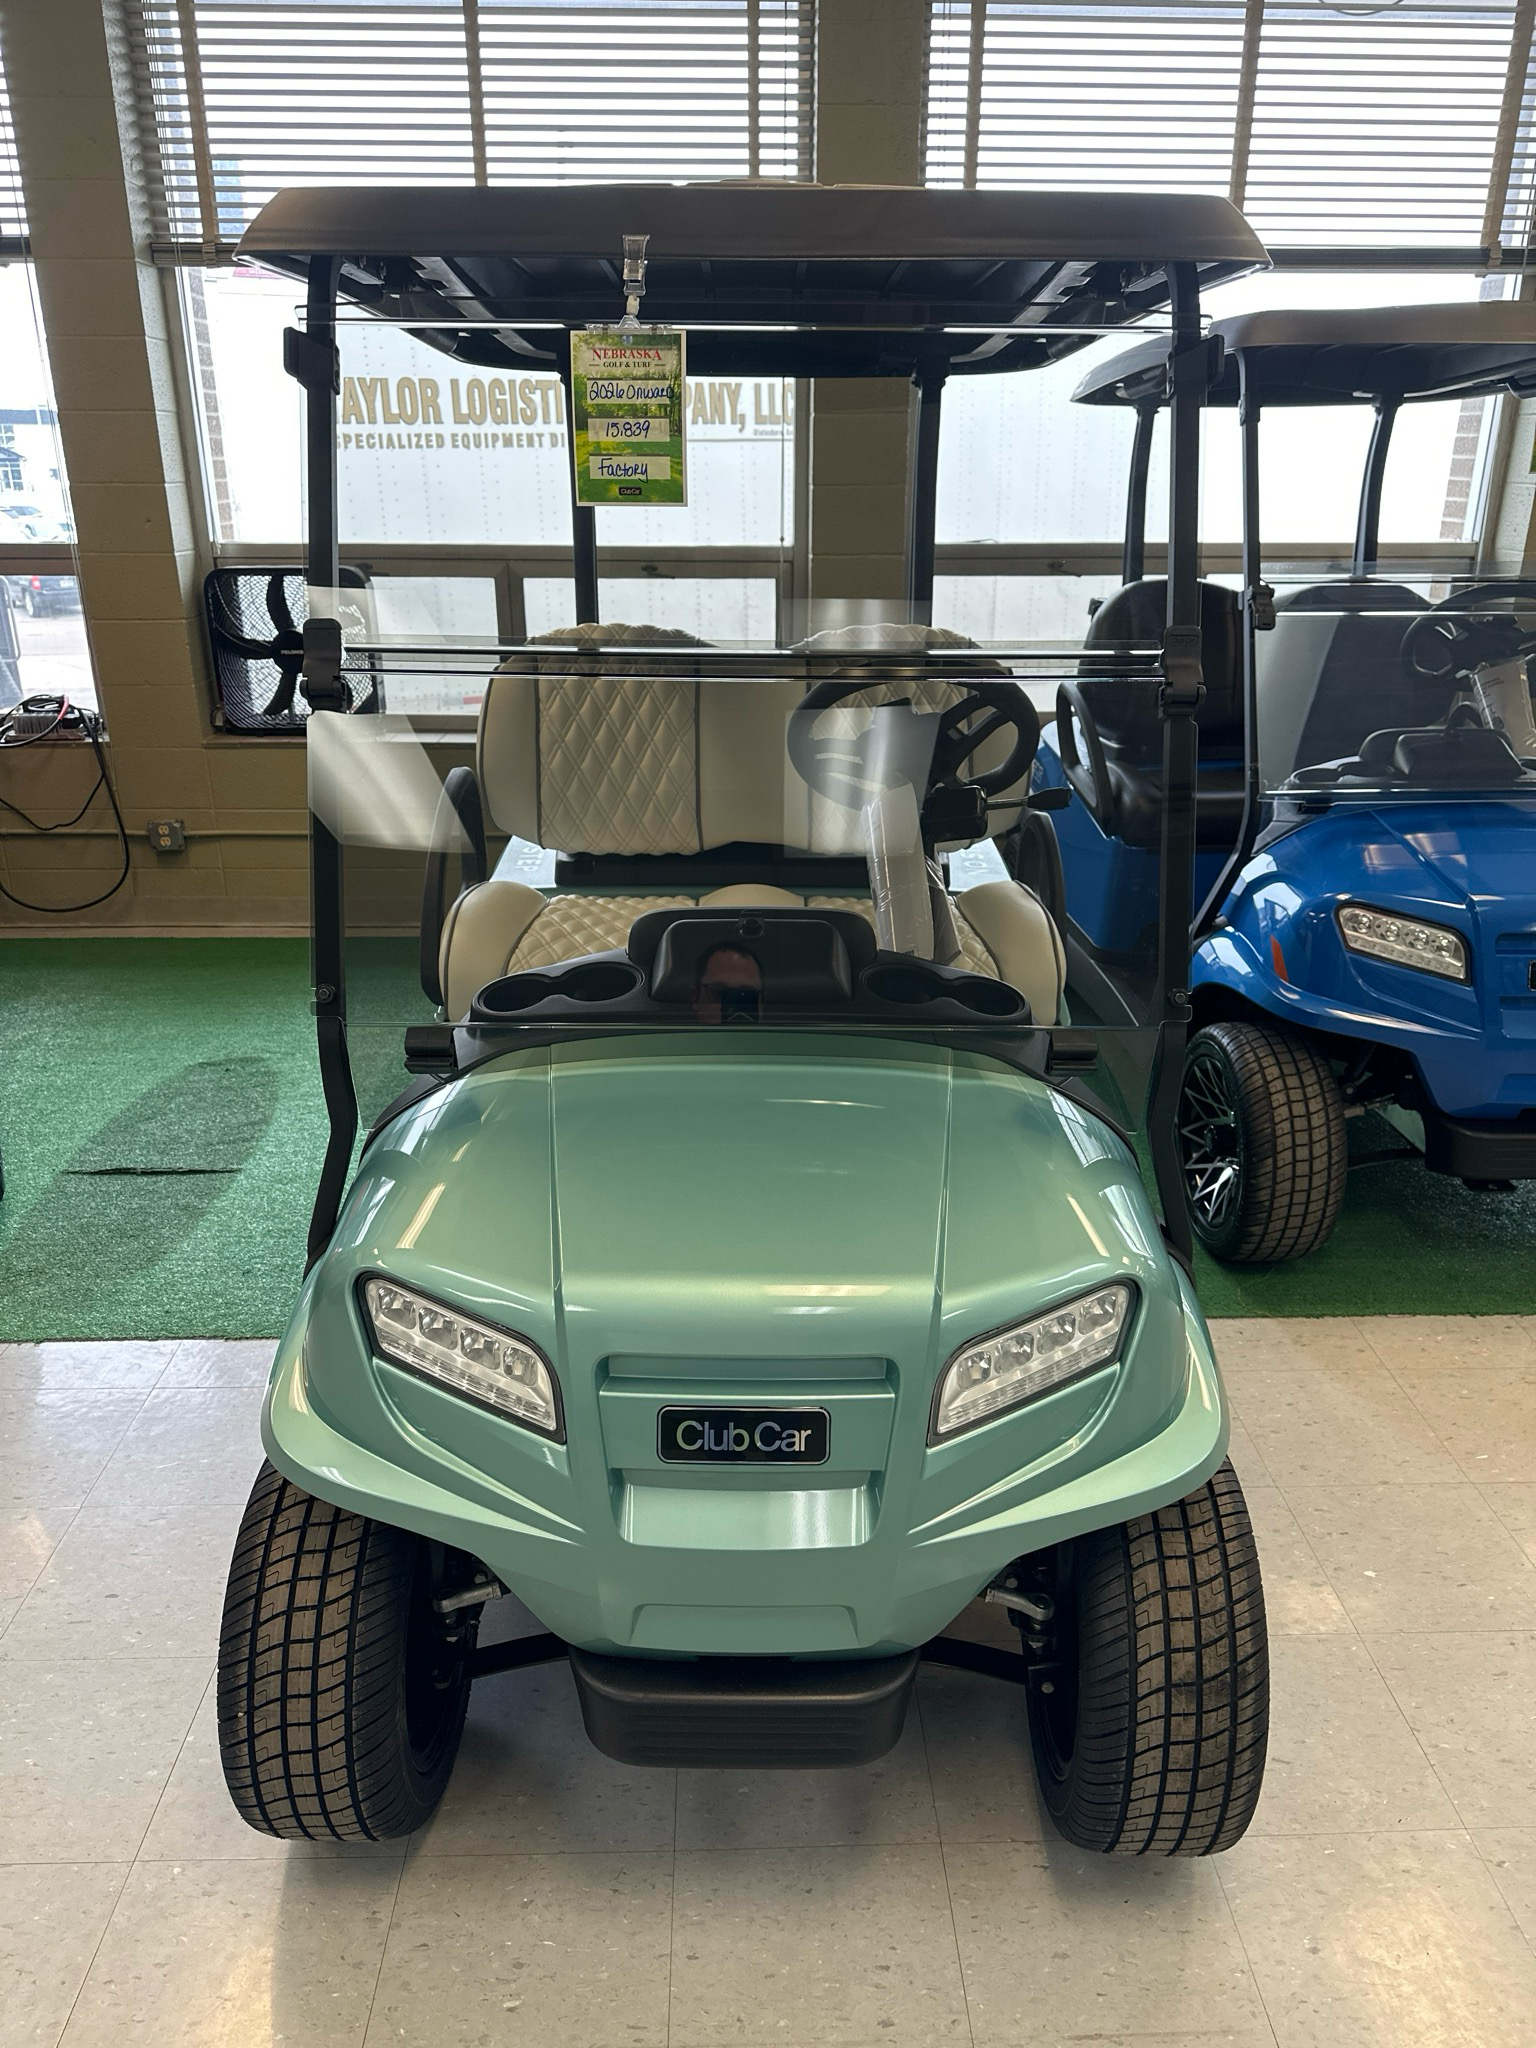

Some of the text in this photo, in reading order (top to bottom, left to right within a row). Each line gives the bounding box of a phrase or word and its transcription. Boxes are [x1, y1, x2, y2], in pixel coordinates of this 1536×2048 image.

[592, 348, 662, 361] NEBRASKA
[342, 376, 444, 426] AYLOR
[450, 377, 565, 426] LOGISTI
[589, 381, 625, 401] 2026
[451, 432, 544, 450] EQUIPMENT
[548, 432, 565, 448] DI
[676, 1420, 812, 1452] Club Car
